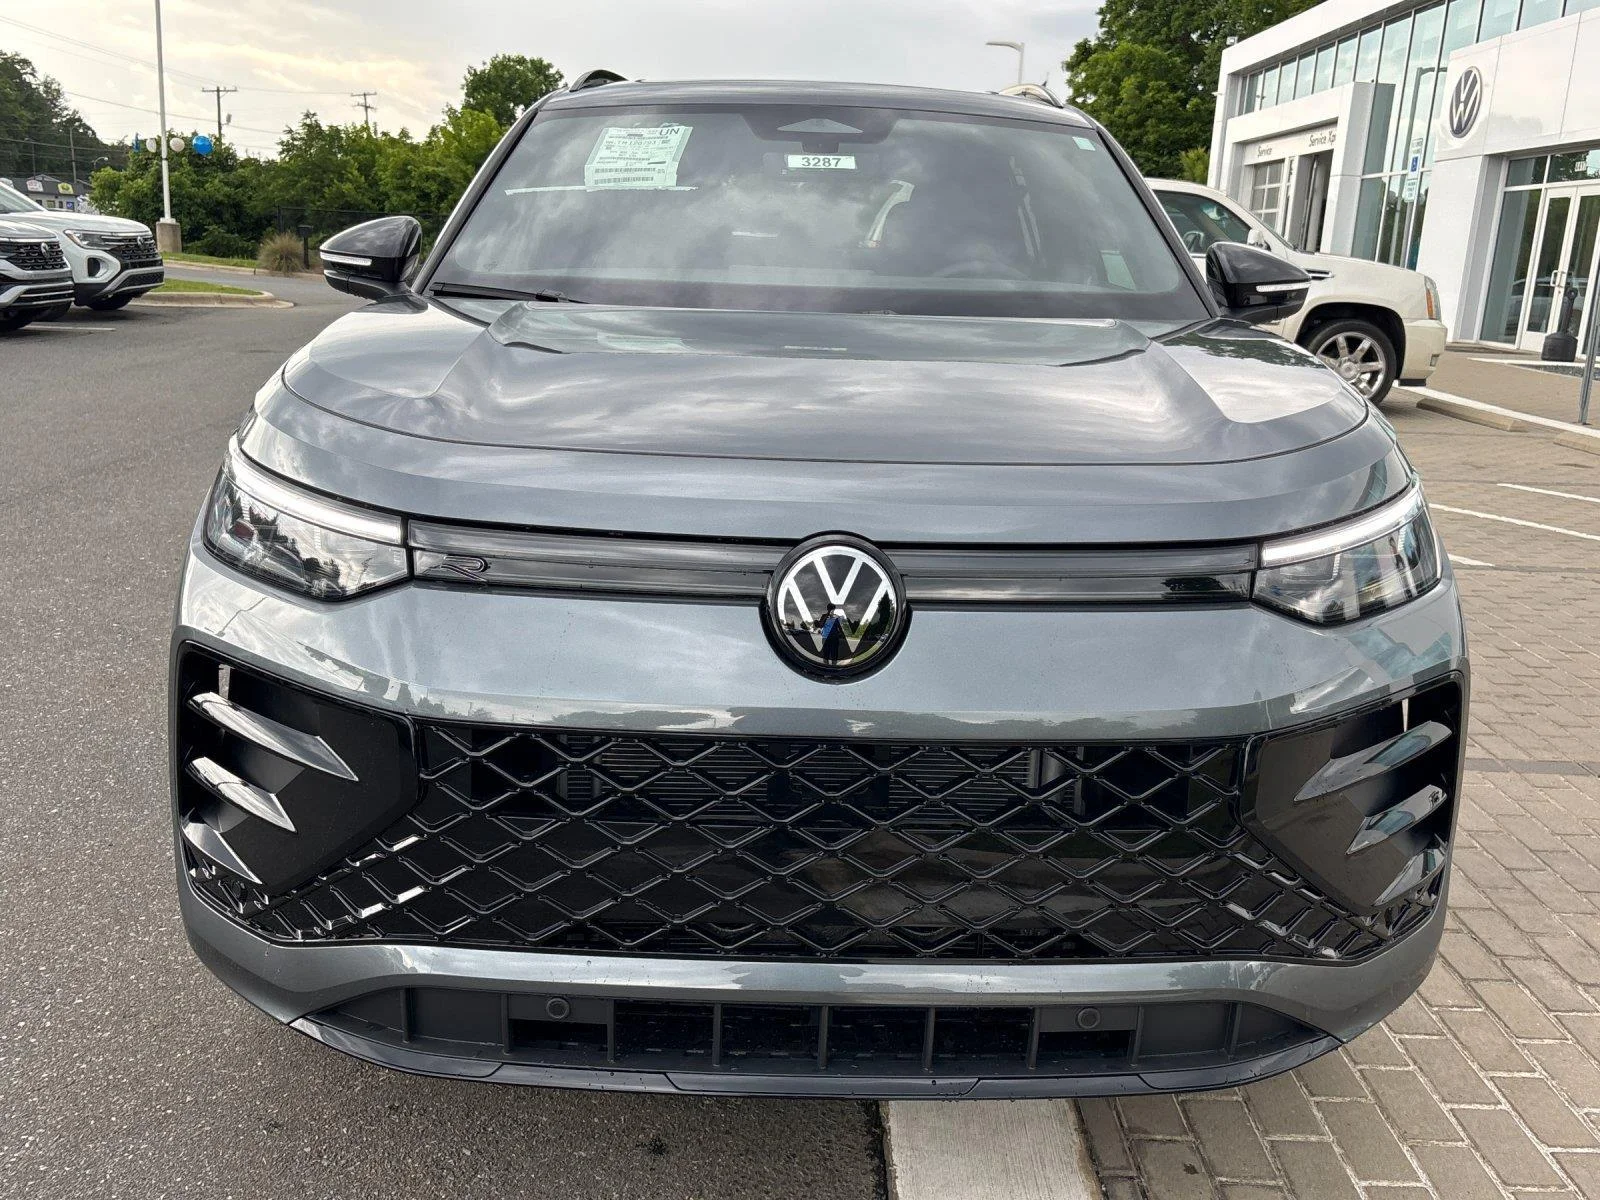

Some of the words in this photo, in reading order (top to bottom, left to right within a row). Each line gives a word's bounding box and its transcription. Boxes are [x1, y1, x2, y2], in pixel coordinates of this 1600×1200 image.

[1309, 132, 1327, 147] Service
[1257, 145, 1273, 158] Service
[801, 156, 842, 168] 3287
